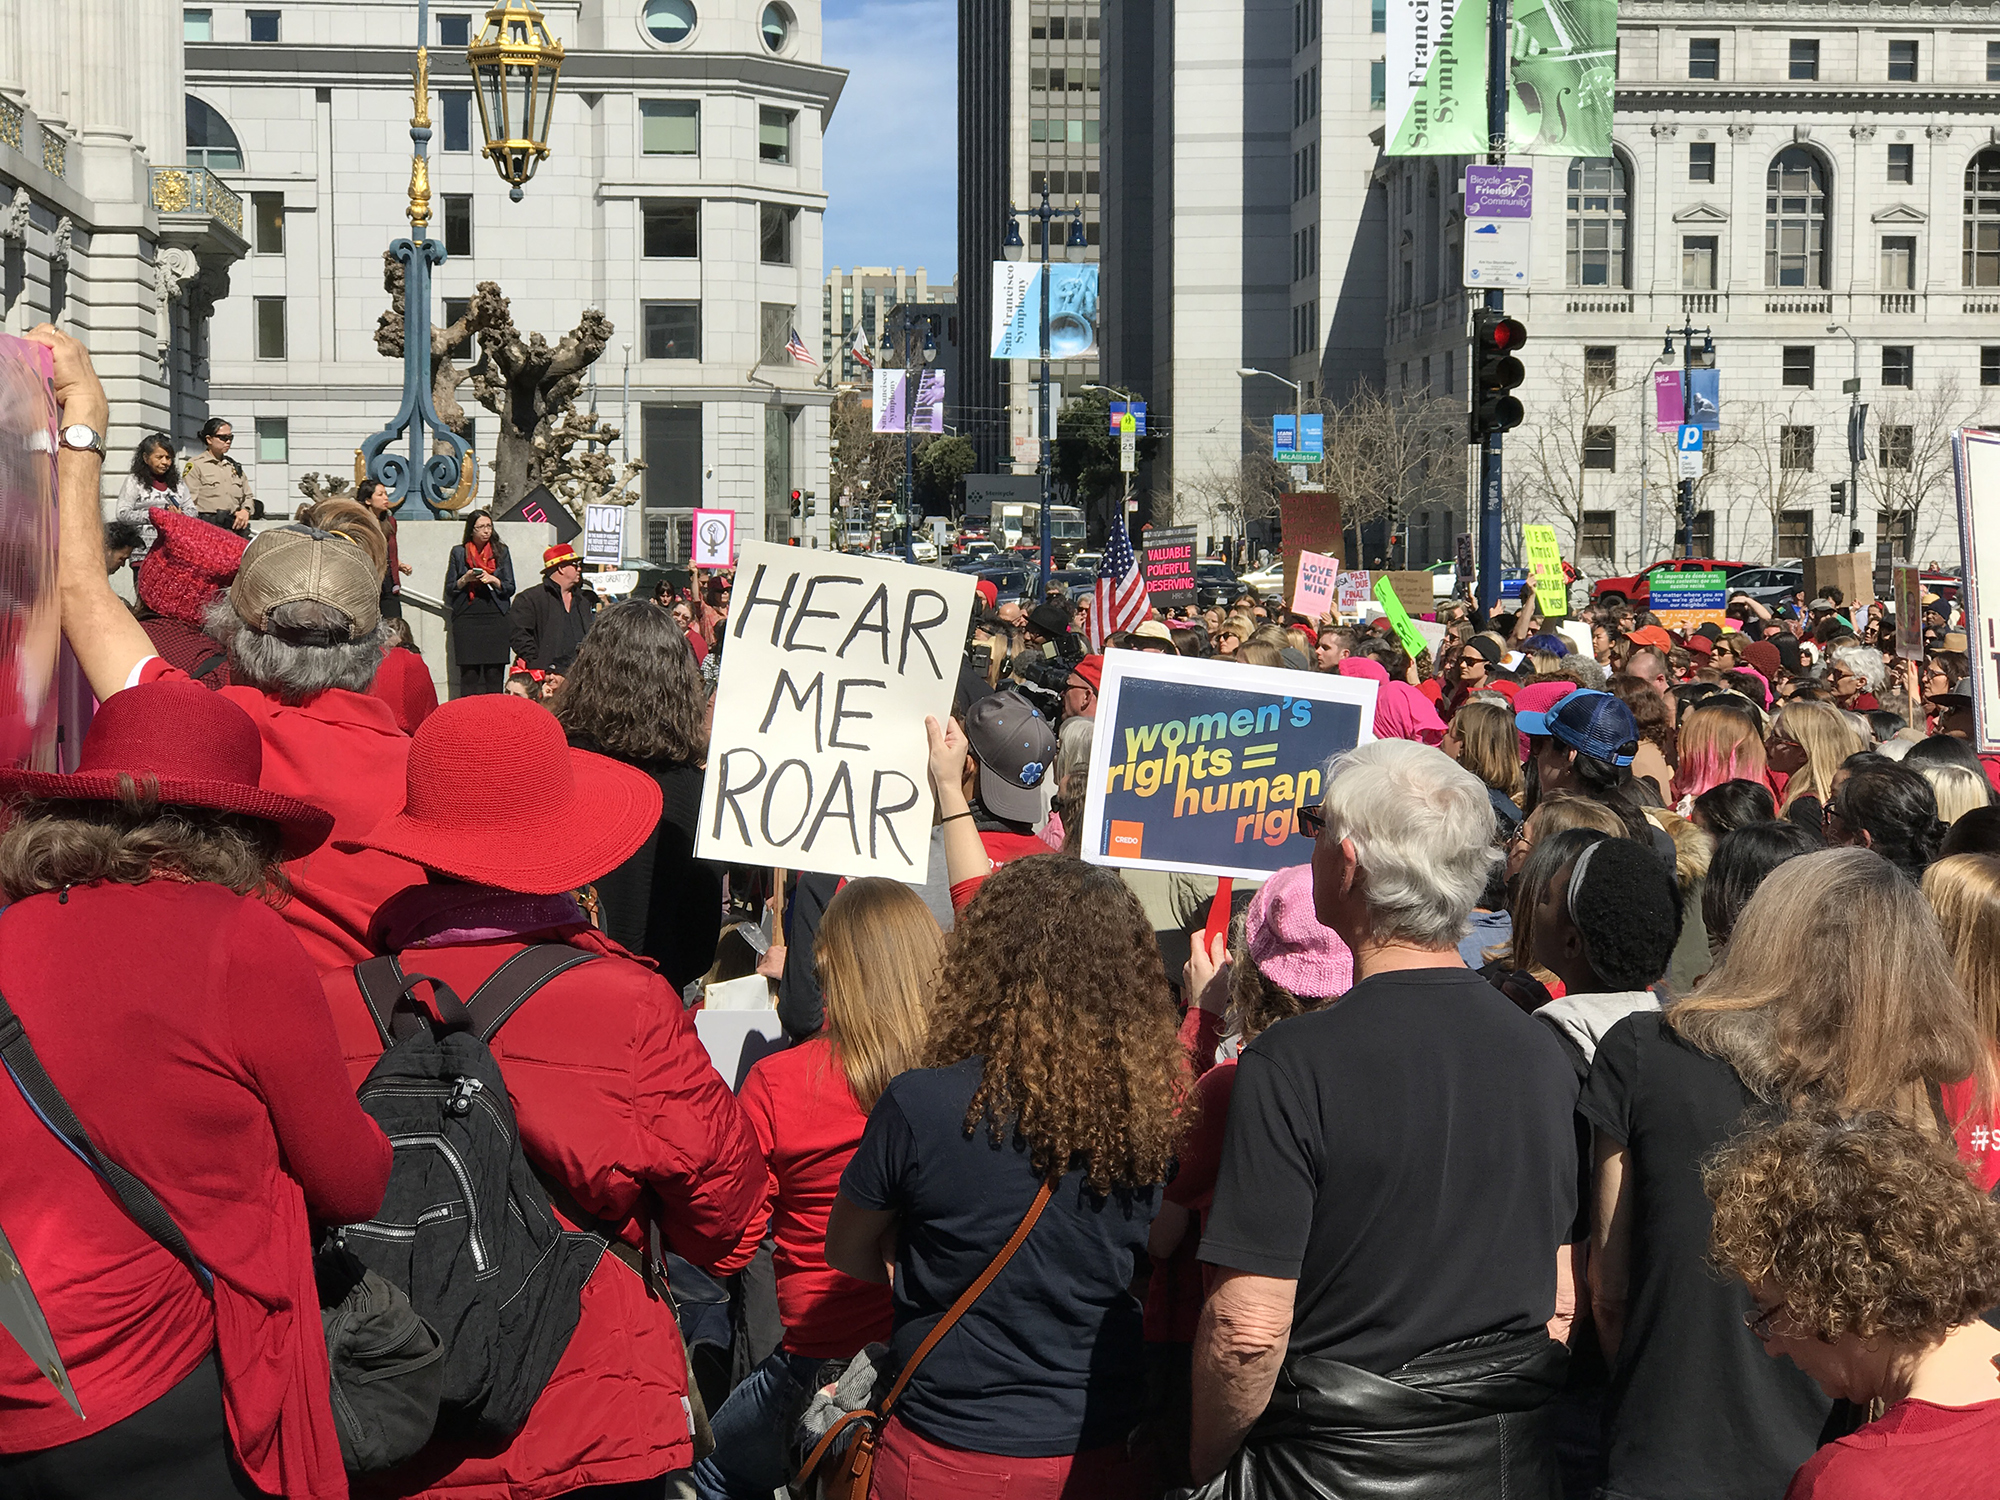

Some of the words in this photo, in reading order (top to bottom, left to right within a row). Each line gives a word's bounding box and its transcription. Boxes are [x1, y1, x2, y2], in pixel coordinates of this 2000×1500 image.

[1408, 100, 1429, 149] San
[1470, 175, 1501, 186] Bicycle
[1475, 186, 1517, 197] Friendly
[1480, 196, 1530, 208] Community
[1003, 265, 1015, 327] Francisco
[1015, 278, 1029, 344] Symphony
[1002, 335, 1013, 355] San
[880, 371, 888, 412] Francisco
[888, 380, 898, 424] Symphony
[588, 507, 620, 533] NO!
[1148, 545, 1191, 561] VALUABLE
[1147, 562, 1191, 577] POWERFUL
[1303, 563, 1333, 577] LOVE
[1350, 571, 1367, 581] PAST
[1146, 577, 1194, 593] DESERVING
[1303, 573, 1330, 587] WILL
[1335, 577, 1349, 587] USA
[1355, 581, 1369, 589] DUE
[1304, 583, 1325, 595] WIN
[1345, 590, 1364, 599] FINAL
[733, 562, 949, 680] HEAR
[758, 668, 887, 753] ME
[1124, 696, 1312, 753] women's
[1106, 744, 1233, 797] rights
[1173, 768, 1322, 818] human
[711, 747, 919, 866] ROAR
[1115, 836, 1139, 845] CREDO
